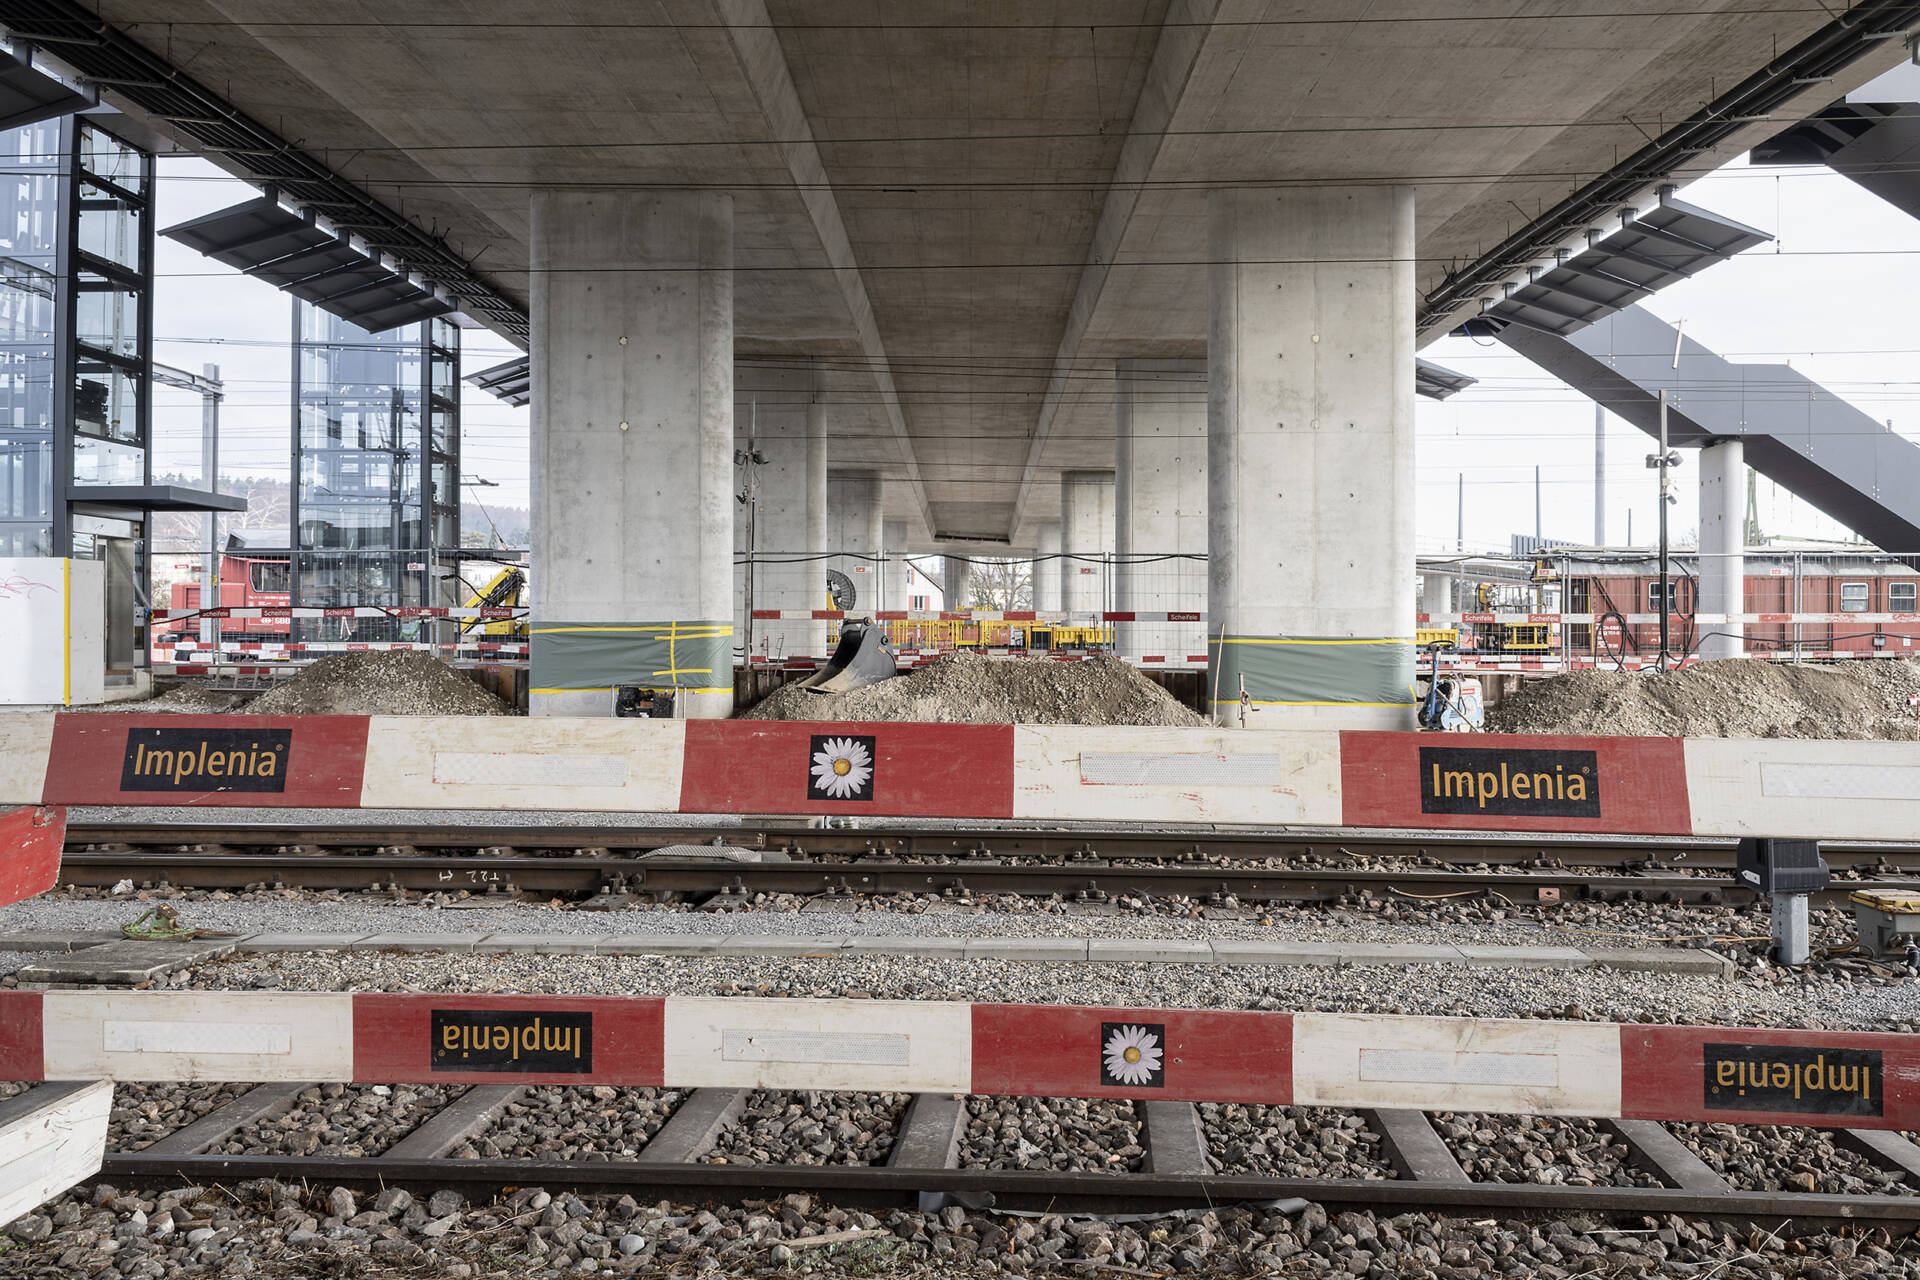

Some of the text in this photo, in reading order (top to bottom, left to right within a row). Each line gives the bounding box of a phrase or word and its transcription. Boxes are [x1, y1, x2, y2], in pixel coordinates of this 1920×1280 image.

[134, 741, 277, 785] Implenia
[1432, 762, 1587, 809] Implenia
[443, 1017, 581, 1060] Implenia
[1717, 1054, 1870, 1099] Implenia
